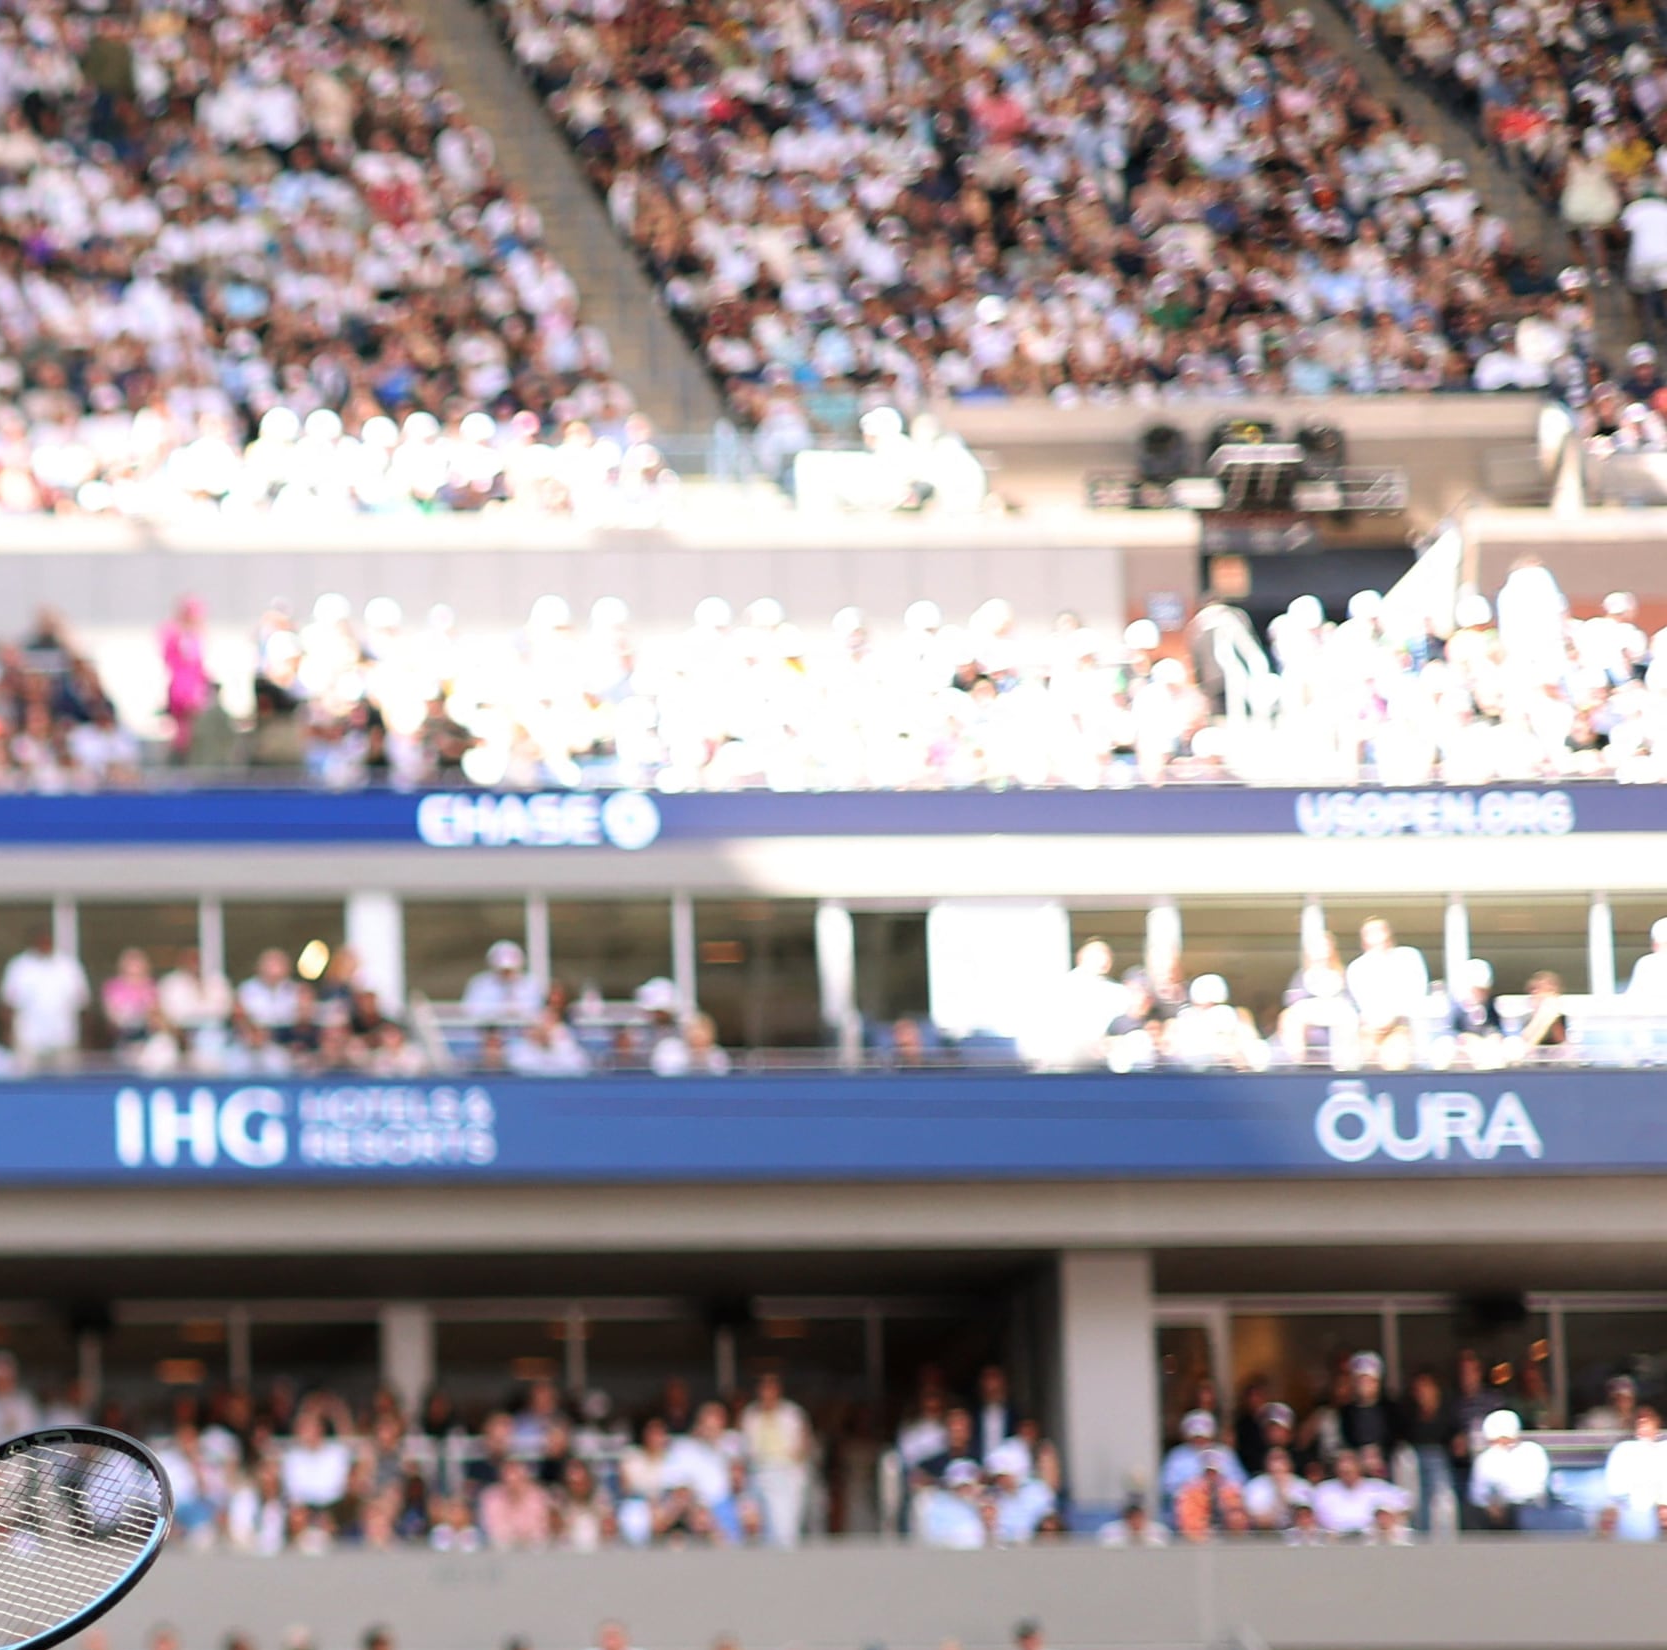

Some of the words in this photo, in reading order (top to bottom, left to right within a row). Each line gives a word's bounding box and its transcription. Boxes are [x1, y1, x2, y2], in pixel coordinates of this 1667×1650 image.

[417, 793, 602, 846] CHASE
[1295, 791, 1575, 836] USOPEN.ORG
[115, 1087, 288, 1168] IHG
[1315, 1079, 1543, 1162] ŌURA
